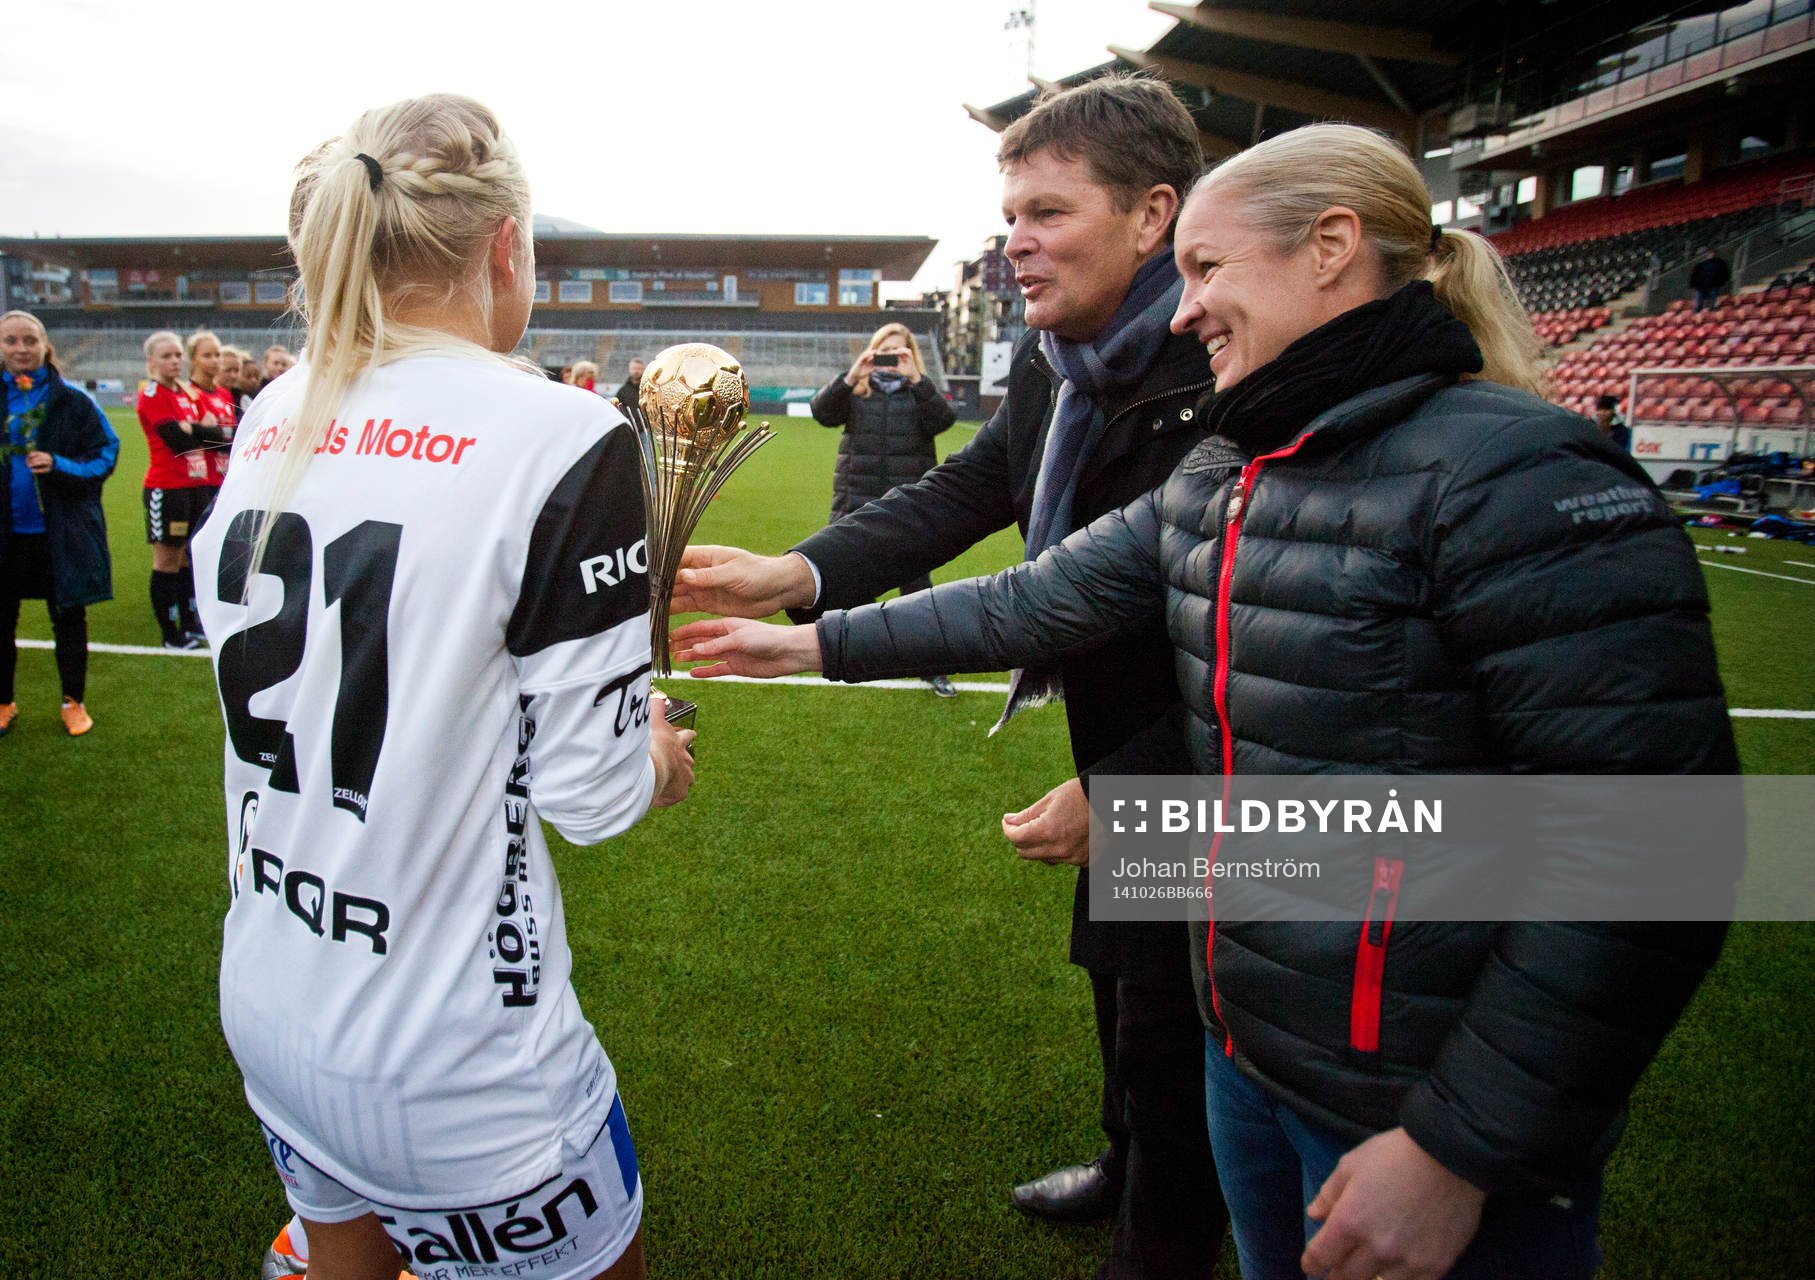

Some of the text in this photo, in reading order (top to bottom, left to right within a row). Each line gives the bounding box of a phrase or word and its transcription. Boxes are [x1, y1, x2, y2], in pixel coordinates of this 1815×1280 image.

[355, 418, 477, 465] Motor
[1571, 499, 1653, 524] report
[217, 509, 404, 823] 21
[520, 894, 541, 985] BUSS
